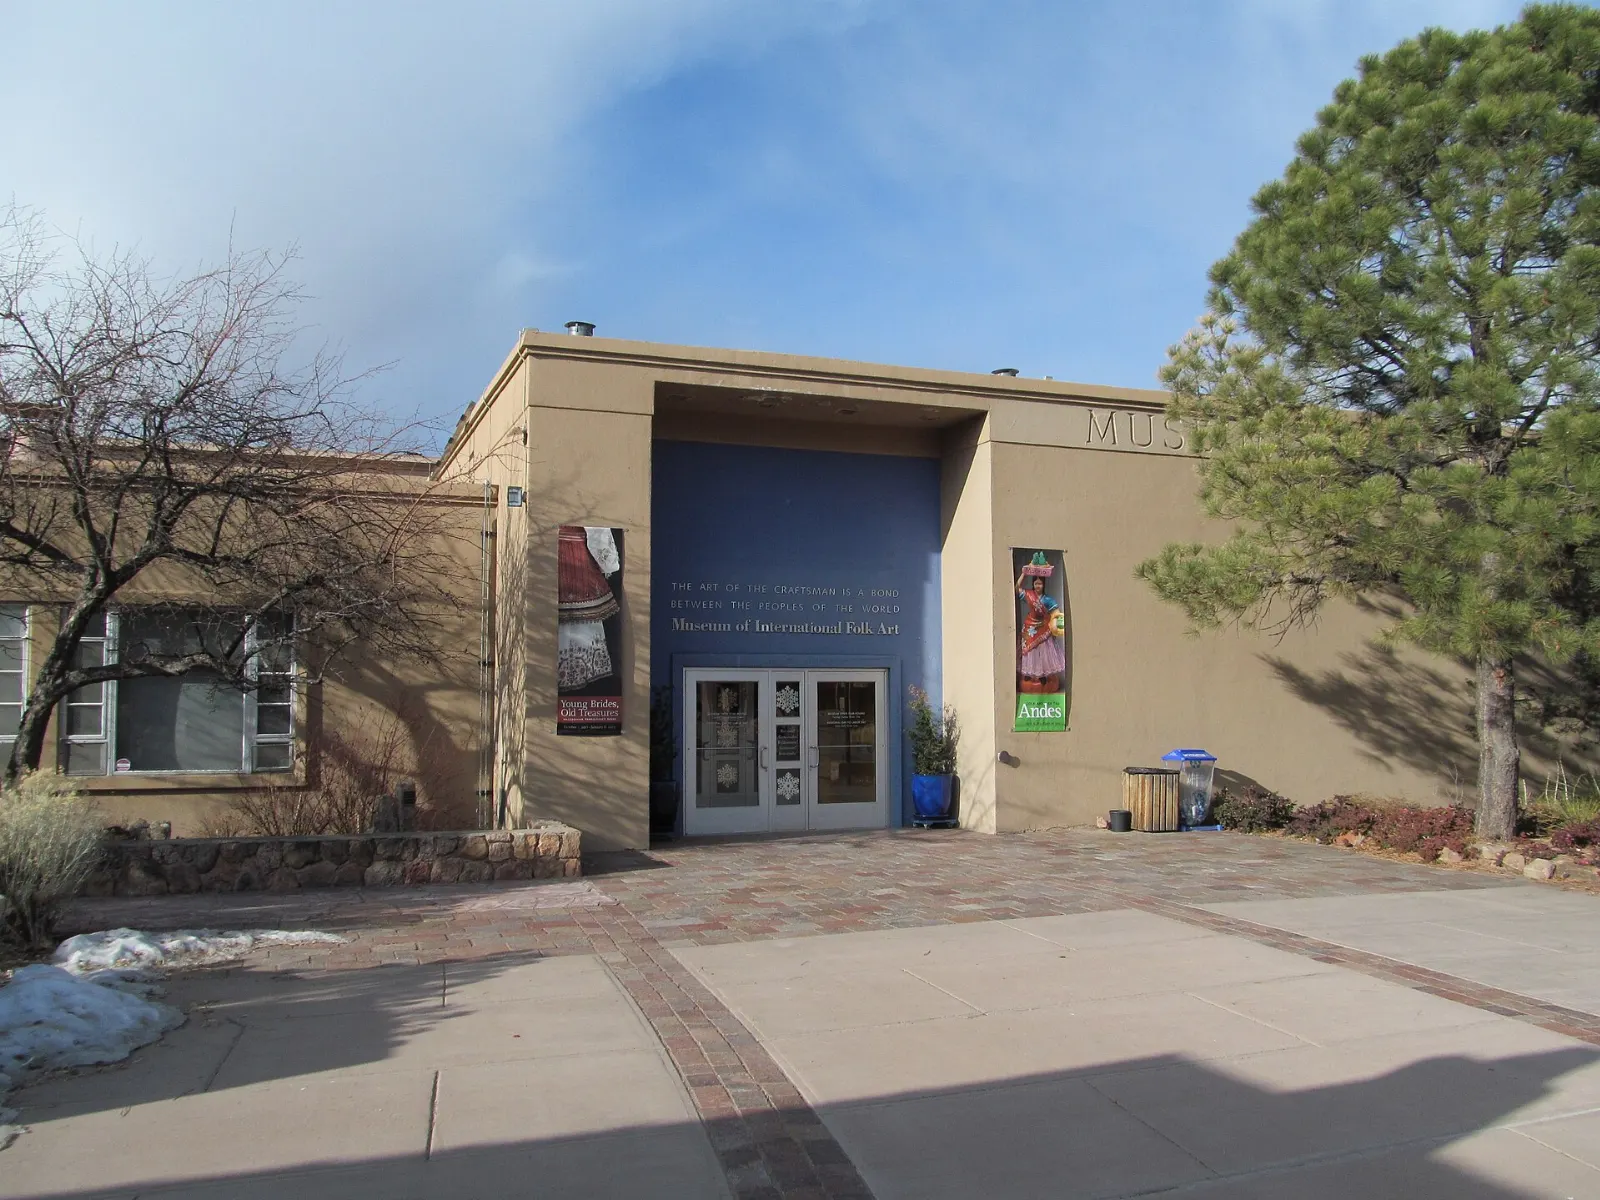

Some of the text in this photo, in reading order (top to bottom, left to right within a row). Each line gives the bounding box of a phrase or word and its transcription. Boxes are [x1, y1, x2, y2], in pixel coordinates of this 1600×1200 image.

[671, 582, 899, 598] THE ART OF THE CRAFTSMAN IS A BOND
[670, 600, 900, 613] BETWEEN THE PEOPLES OF THE WORLD
[671, 617, 900, 635] Museum of International Folk Art
[560, 699, 619, 710] Young Brides,
[1018, 702, 1062, 719] Andes
[560, 708, 619, 717] Old Treasures
